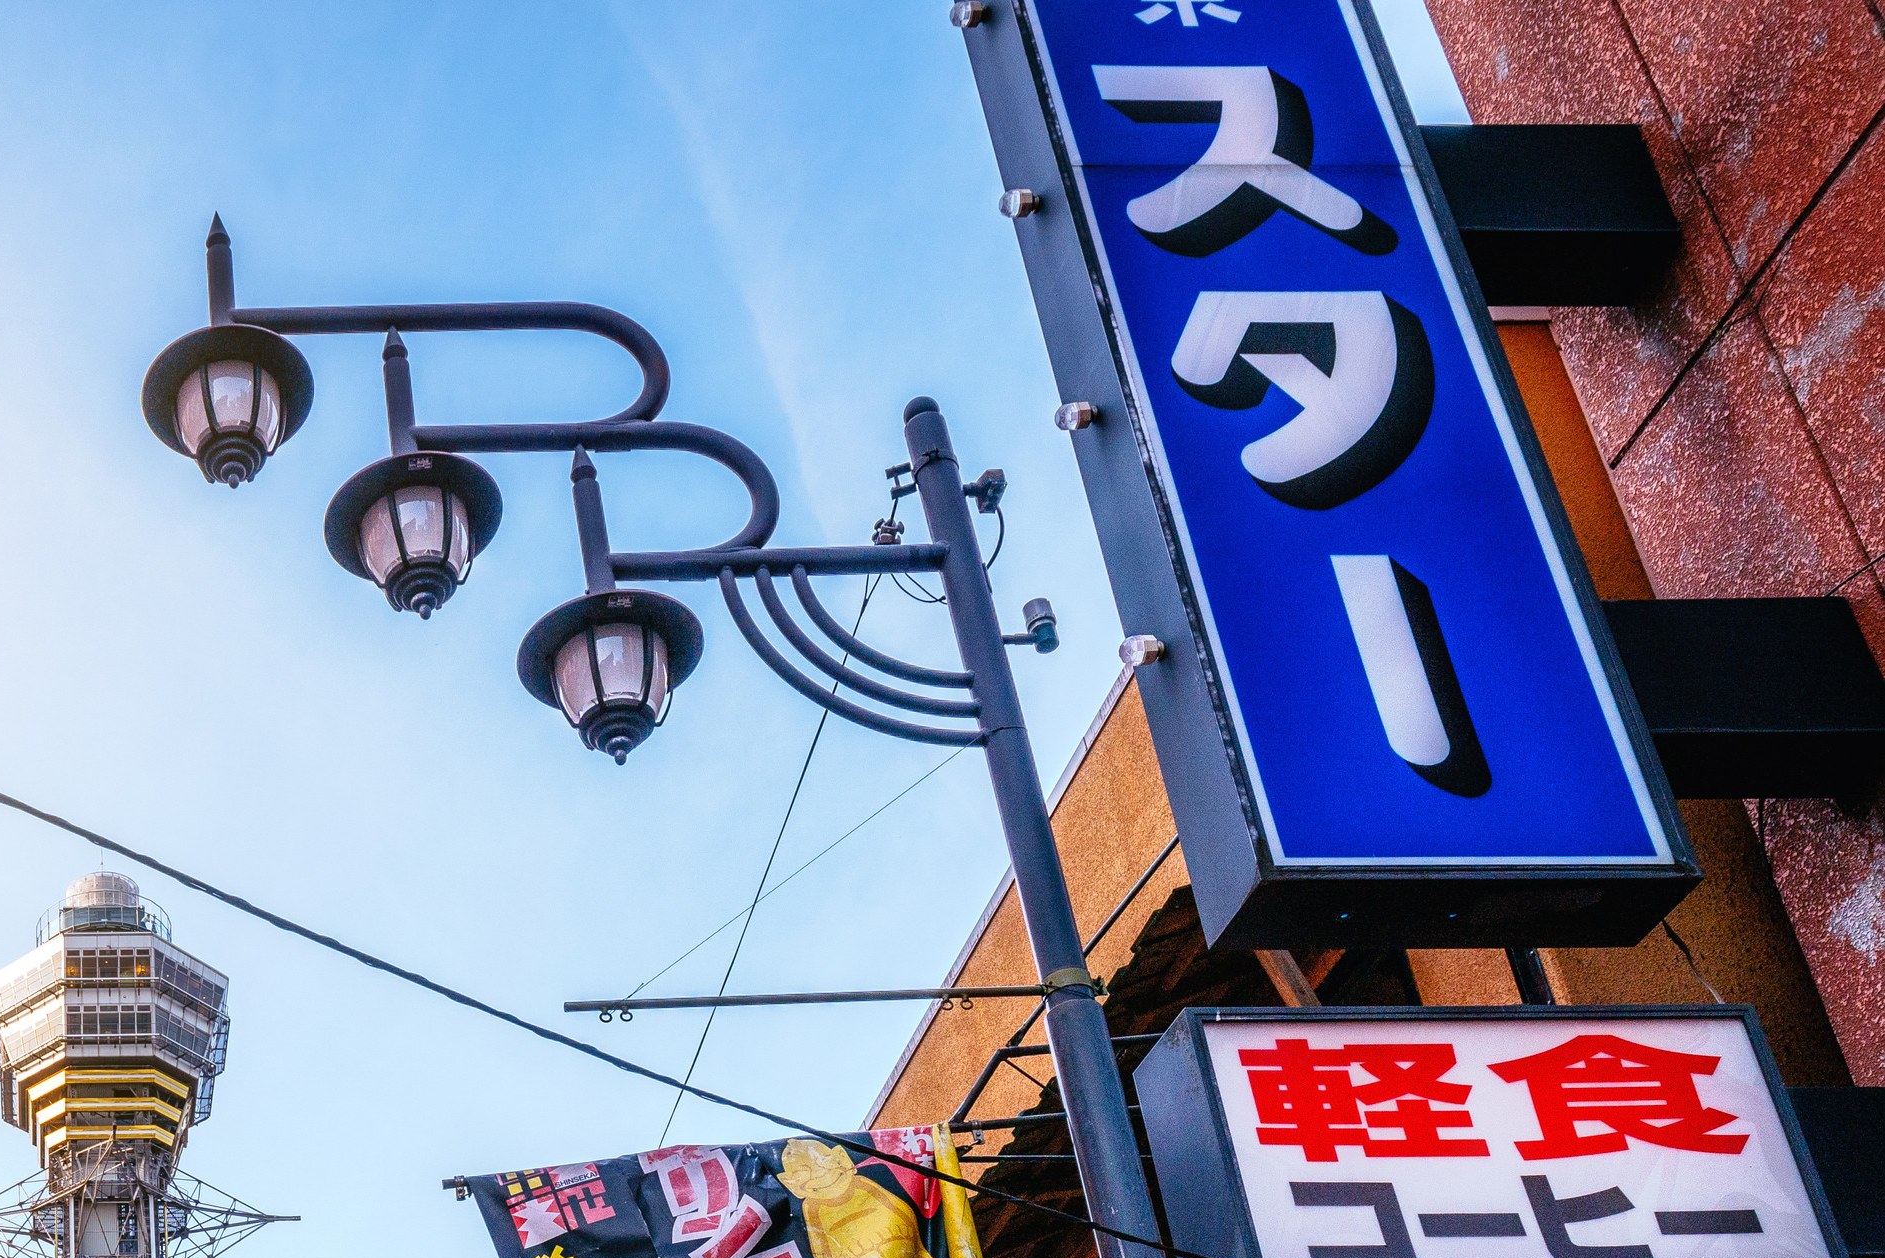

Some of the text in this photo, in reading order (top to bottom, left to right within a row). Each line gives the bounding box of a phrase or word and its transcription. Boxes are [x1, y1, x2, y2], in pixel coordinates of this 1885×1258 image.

[1092, 66, 1486, 794] スター
[1239, 1034, 1749, 1161] 軽食
